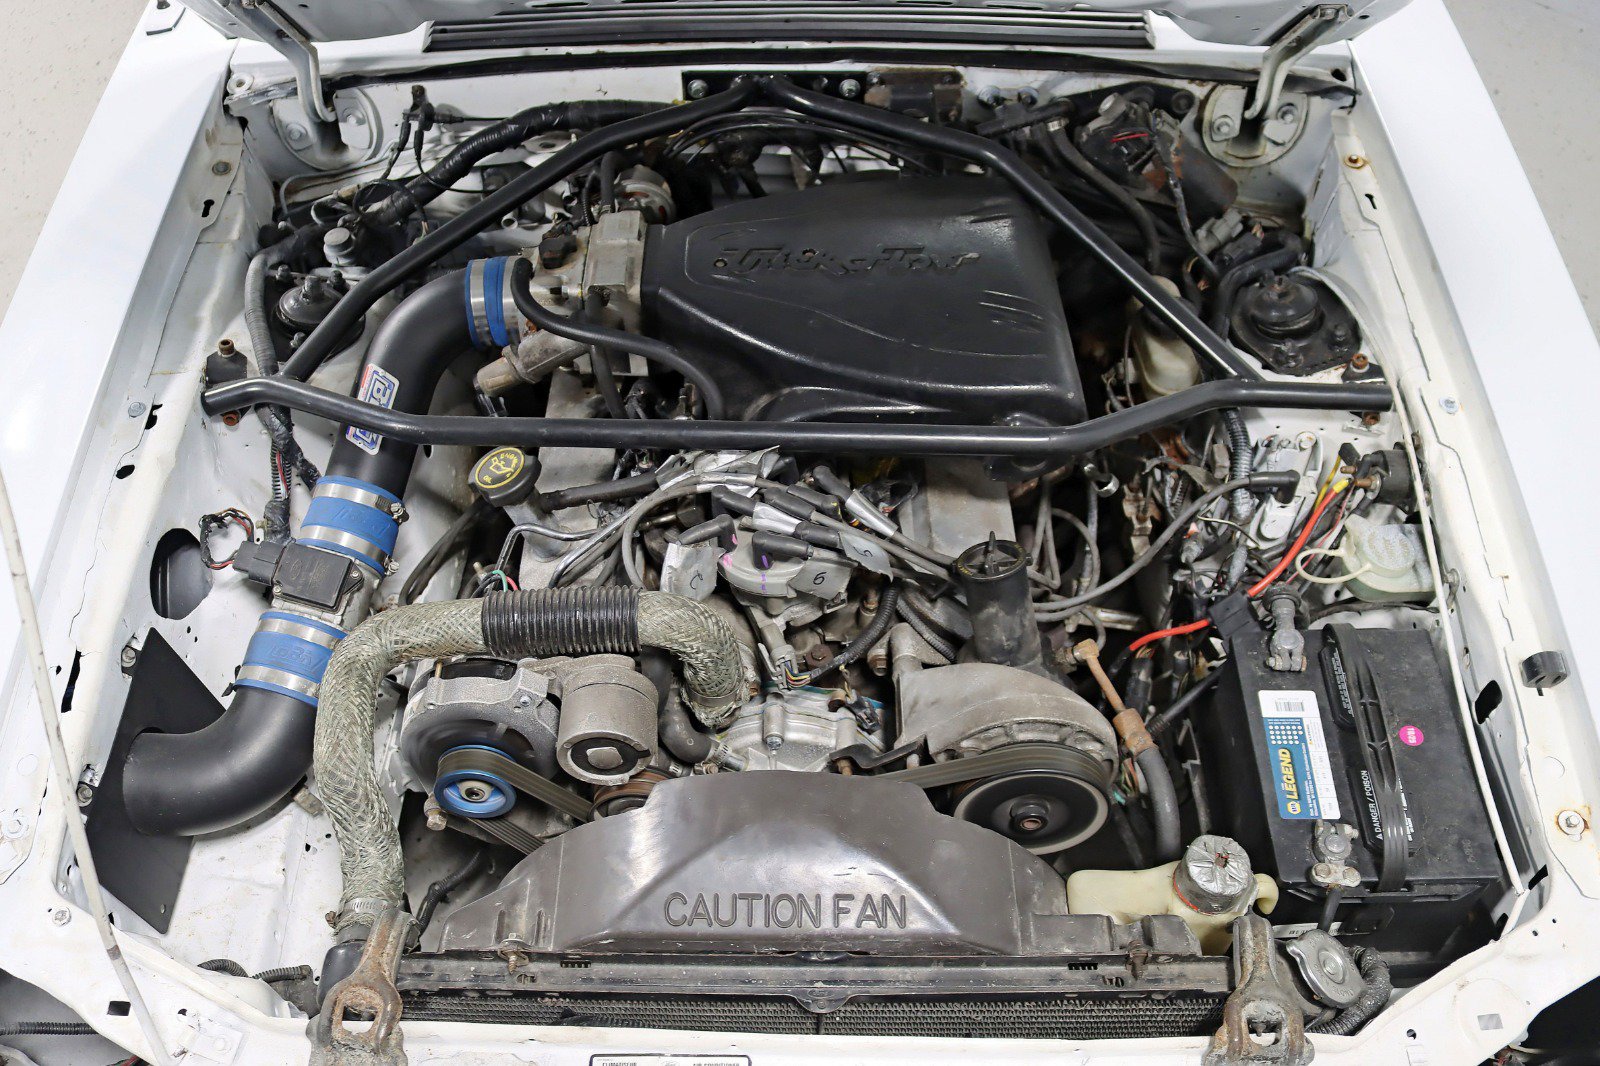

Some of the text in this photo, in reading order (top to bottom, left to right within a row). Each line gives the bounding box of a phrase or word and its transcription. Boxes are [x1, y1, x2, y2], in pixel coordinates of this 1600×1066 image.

[812, 571, 827, 586] 6
[1278, 748, 1299, 800] LEGEND
[1361, 770, 1372, 796] POISON
[1369, 803, 1382, 833] DANGER
[664, 892, 906, 929] CAUTION FAN
